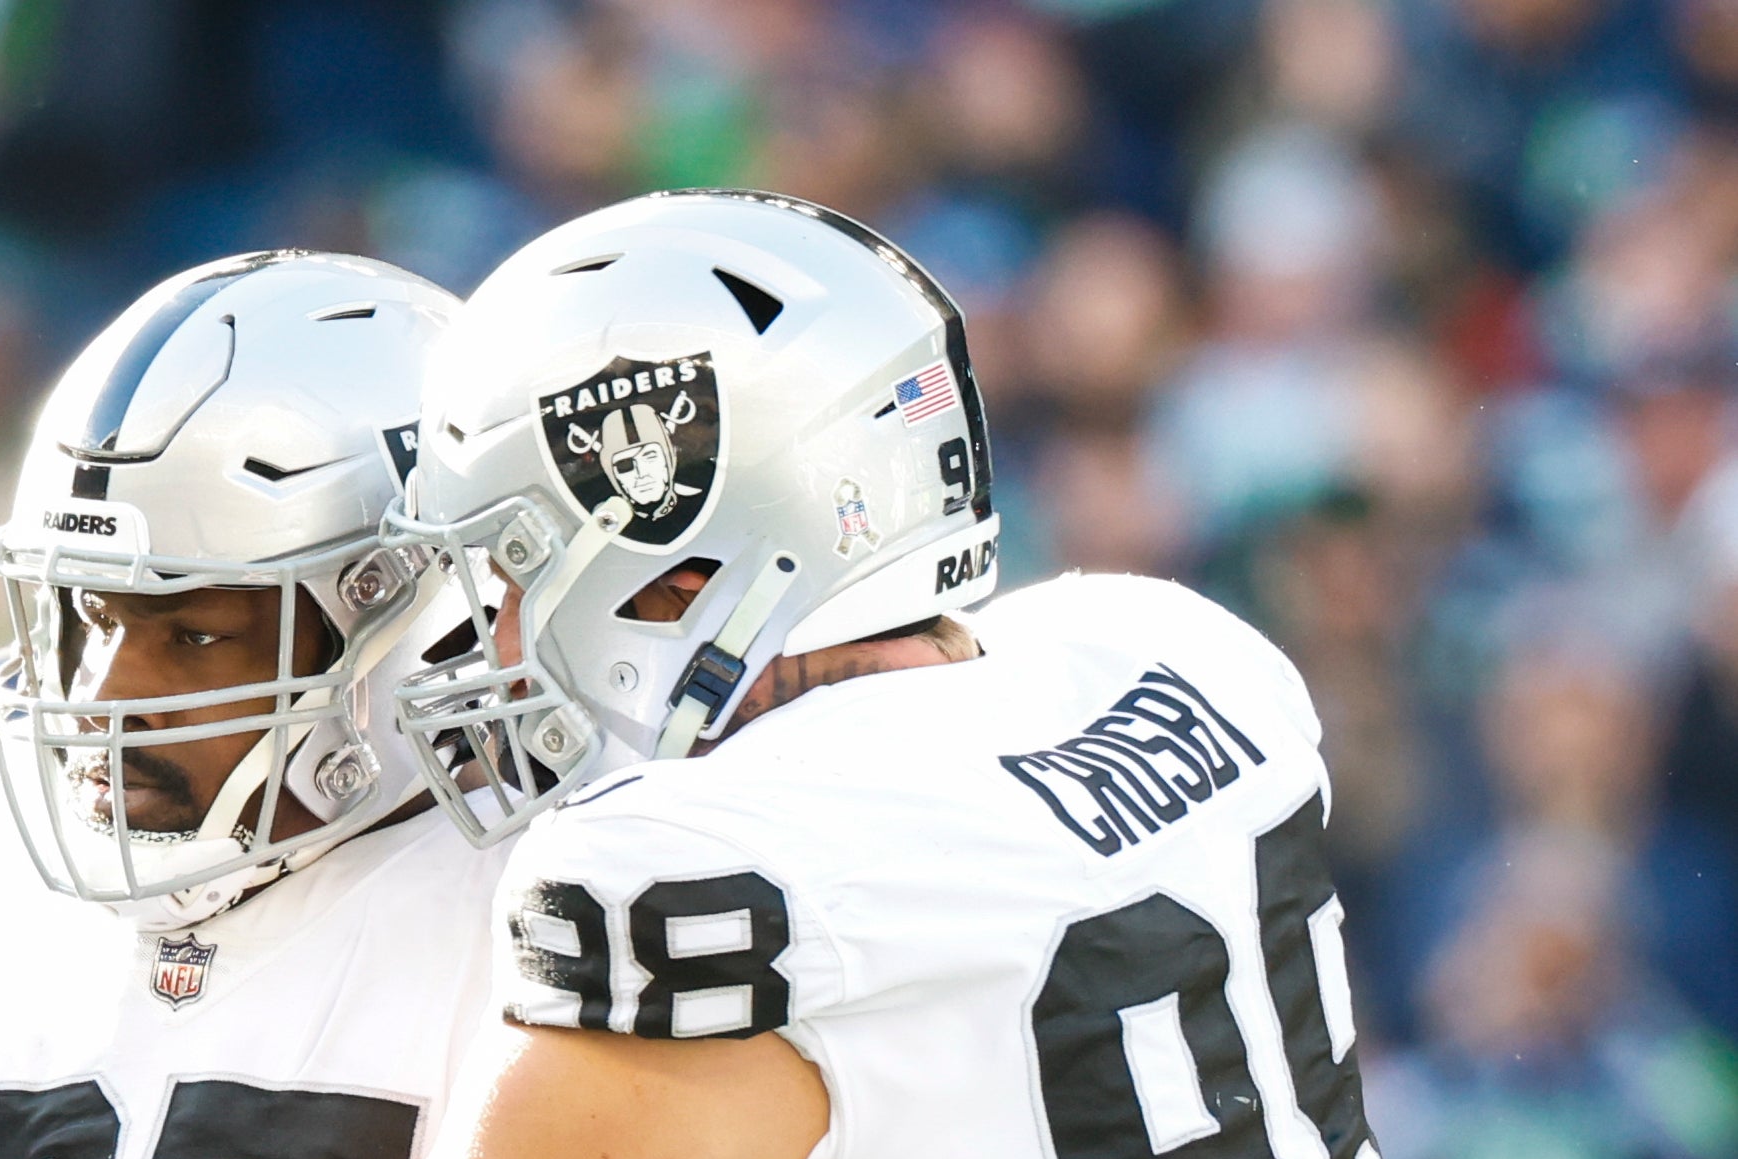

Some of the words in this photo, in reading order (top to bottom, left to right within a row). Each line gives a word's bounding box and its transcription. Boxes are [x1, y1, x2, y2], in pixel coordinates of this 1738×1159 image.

[554, 359, 698, 418] RAIDERS
[938, 436, 972, 516] 9
[43, 510, 117, 537] RAIDERS
[935, 537, 998, 595] RAID
[995, 661, 1267, 858] CROSBY
[157, 964, 198, 997] NFL
[502, 868, 792, 1041] 98
